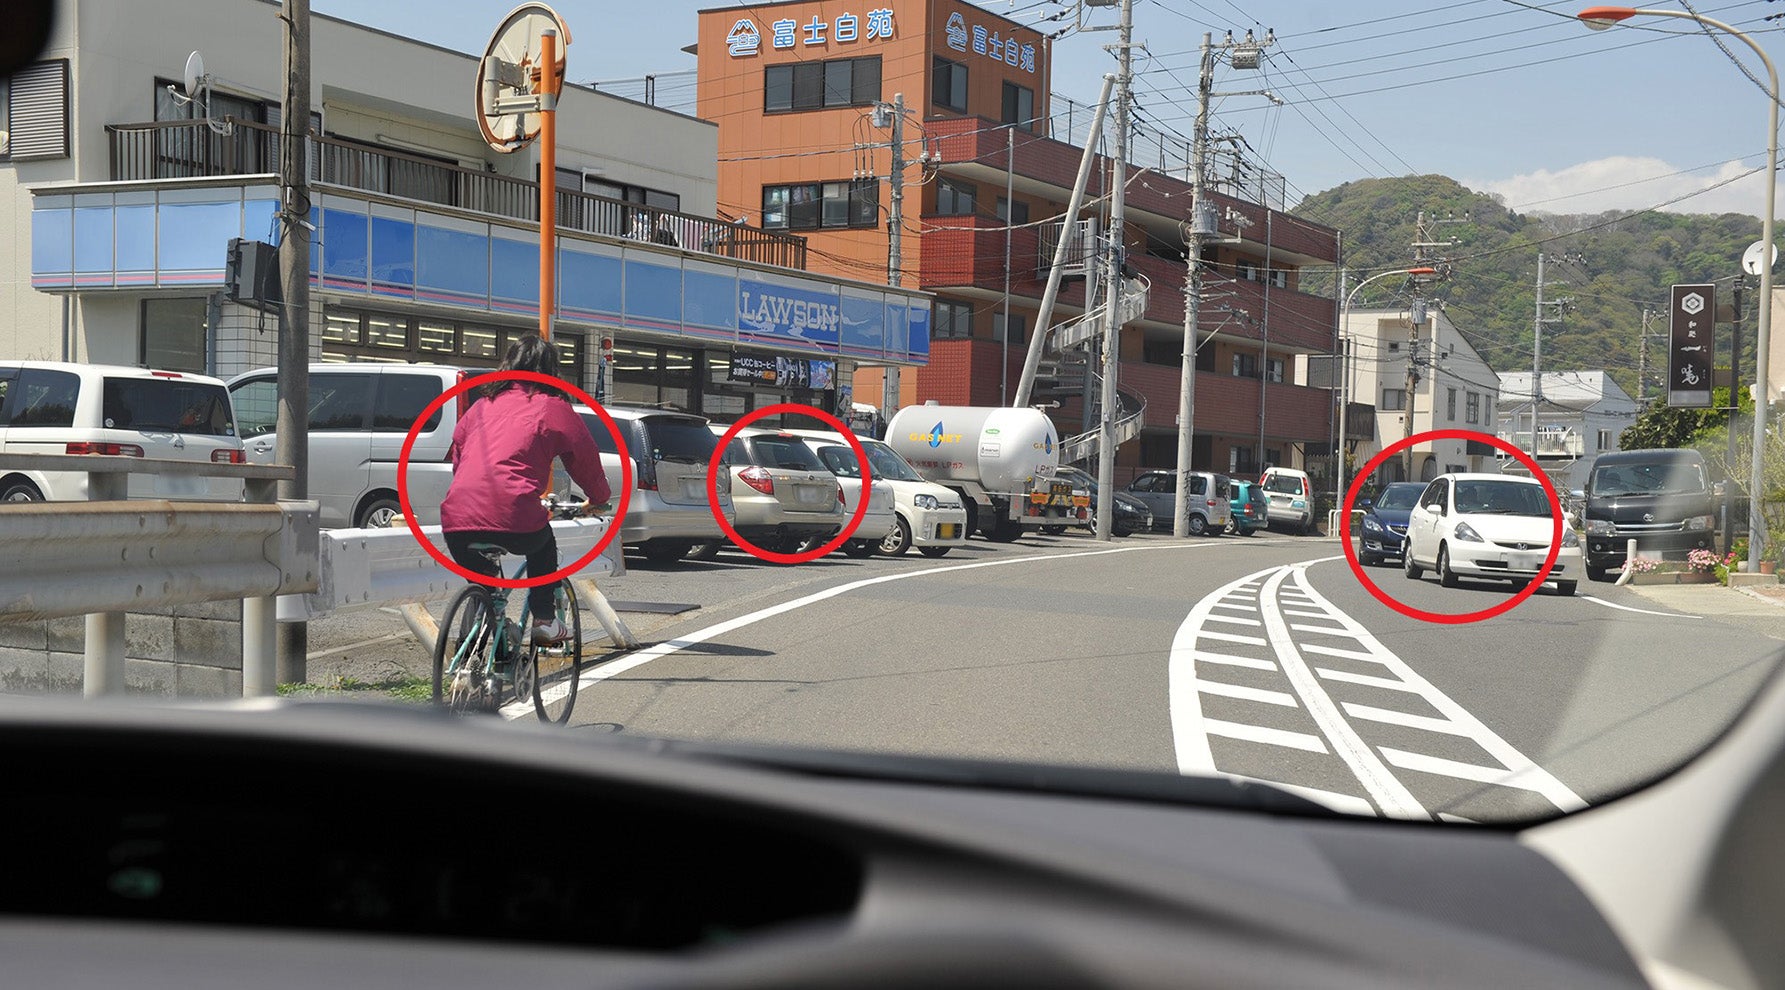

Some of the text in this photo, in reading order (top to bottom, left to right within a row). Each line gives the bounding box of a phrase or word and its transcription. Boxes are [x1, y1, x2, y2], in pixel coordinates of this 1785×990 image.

[772, 9, 894, 49] 富士白苑
[972, 25, 1036, 74] 富士白苑
[742, 291, 837, 332] LAWSON
